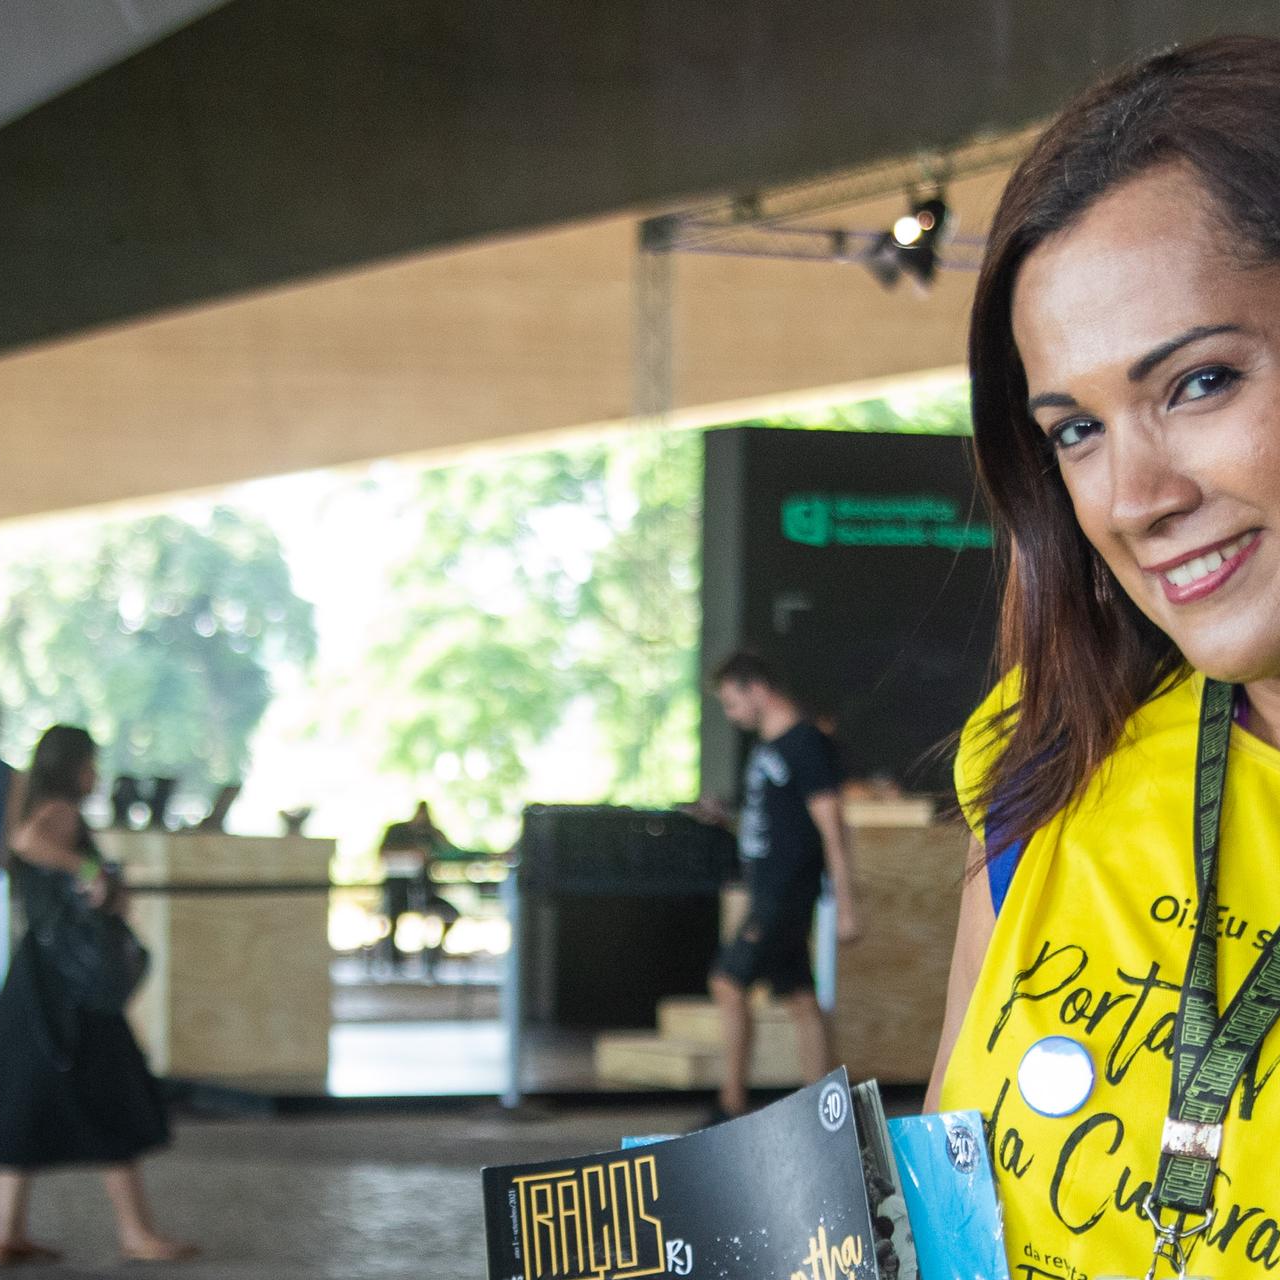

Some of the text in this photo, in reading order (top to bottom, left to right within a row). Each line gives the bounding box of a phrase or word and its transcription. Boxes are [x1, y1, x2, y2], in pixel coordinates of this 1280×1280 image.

[987, 941, 1177, 1087] Porta
[665, 1238, 693, 1276] RJ
[1023, 1243, 1041, 1262] da
